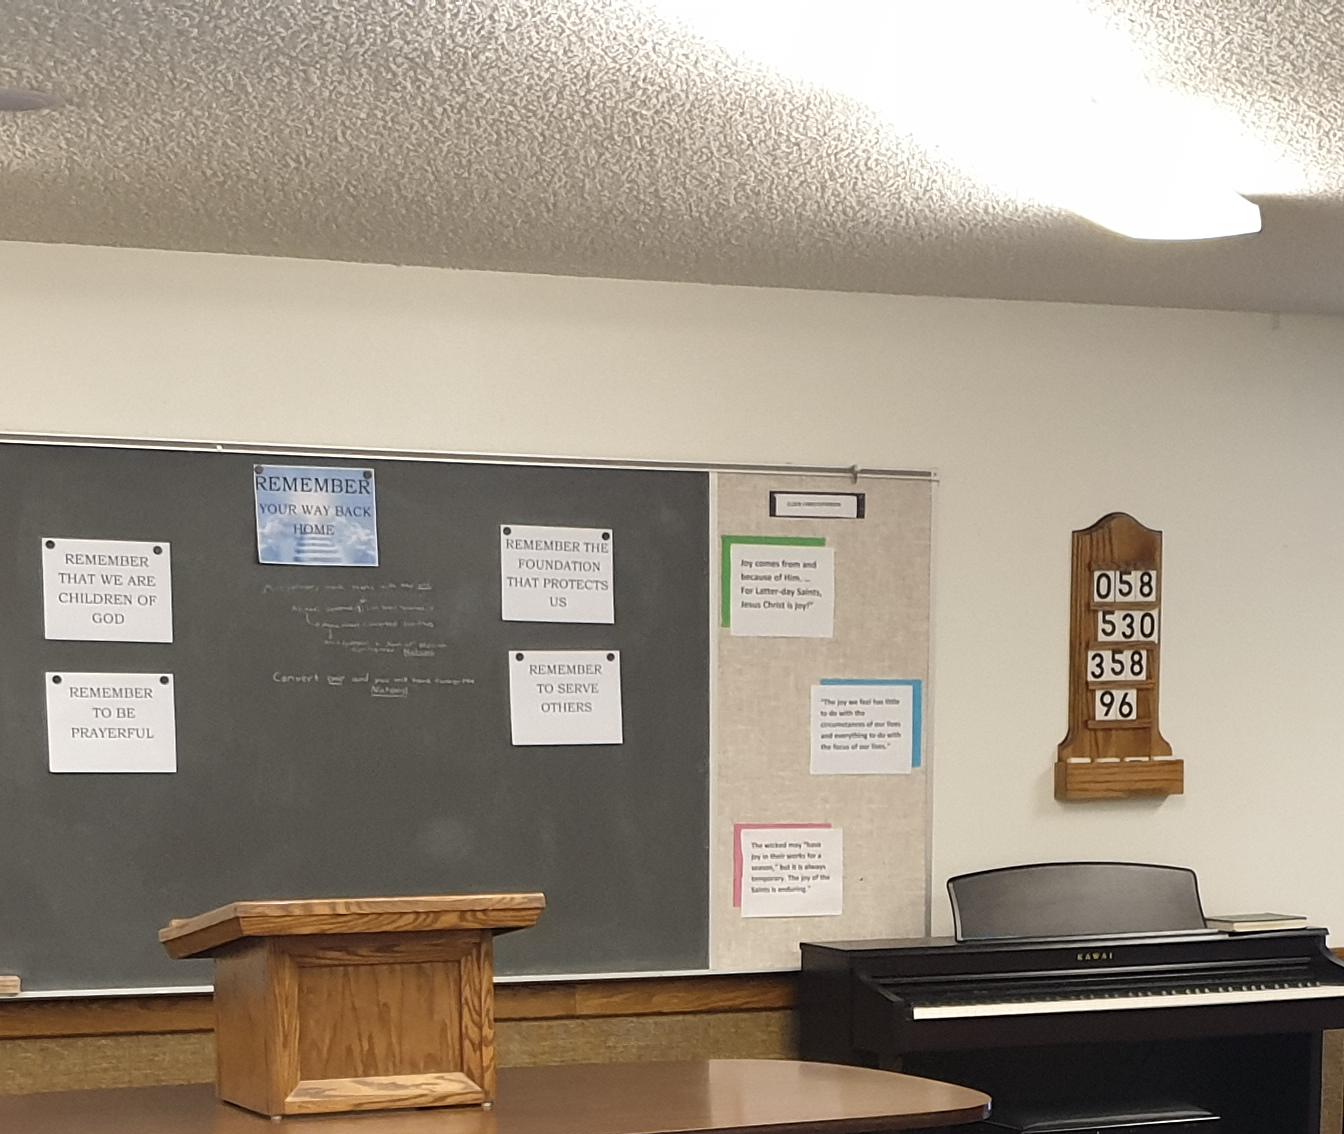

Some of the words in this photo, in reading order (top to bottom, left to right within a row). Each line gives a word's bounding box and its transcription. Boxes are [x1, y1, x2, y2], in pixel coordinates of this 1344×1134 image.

[256, 476, 370, 494] REMEMBER
[259, 503, 297, 514] YOUR
[300, 505, 330, 516] WAY
[335, 506, 371, 517] BACK
[294, 524, 335, 535] HOME
[506, 539, 580, 552] REMEMBER
[584, 542, 608, 553] THE
[65, 553, 149, 567] REMEMBER
[518, 559, 600, 571] FOUNDATION
[741, 560, 753, 570] Joy
[782, 561, 799, 569] from
[802, 560, 817, 569] and
[58, 573, 95, 584] THAT
[101, 575, 123, 586] WE
[127, 576, 156, 586] ARE
[507, 577, 539, 587] THAT
[543, 578, 608, 590] PROTECTS
[774, 574, 782, 582] of
[1096, 571, 1153, 599] 058
[741, 587, 753, 595] For
[755, 587, 795, 598] Latter-day
[58, 592, 132, 605] CHILDREN
[137, 595, 157, 606] OF
[550, 597, 567, 607] US
[741, 601, 761, 609] Jesus
[763, 601, 785, 609] Christ
[787, 601, 793, 609] is
[92, 613, 125, 624] GOD
[1101, 610, 1155, 639] 530
[529, 665, 602, 675] REMEMBER
[1091, 651, 1144, 679] 358
[69, 687, 153, 699] REMEMBER
[537, 684, 553, 693] TO
[558, 683, 599, 694] SERVE
[541, 702, 592, 712] OTHERS
[1100, 690, 1133, 718] 96
[92, 707, 112, 718] TO
[116, 708, 136, 719] BE
[71, 728, 154, 739] PRAYERFUL
[1077, 952, 1112, 960] KAWAI
